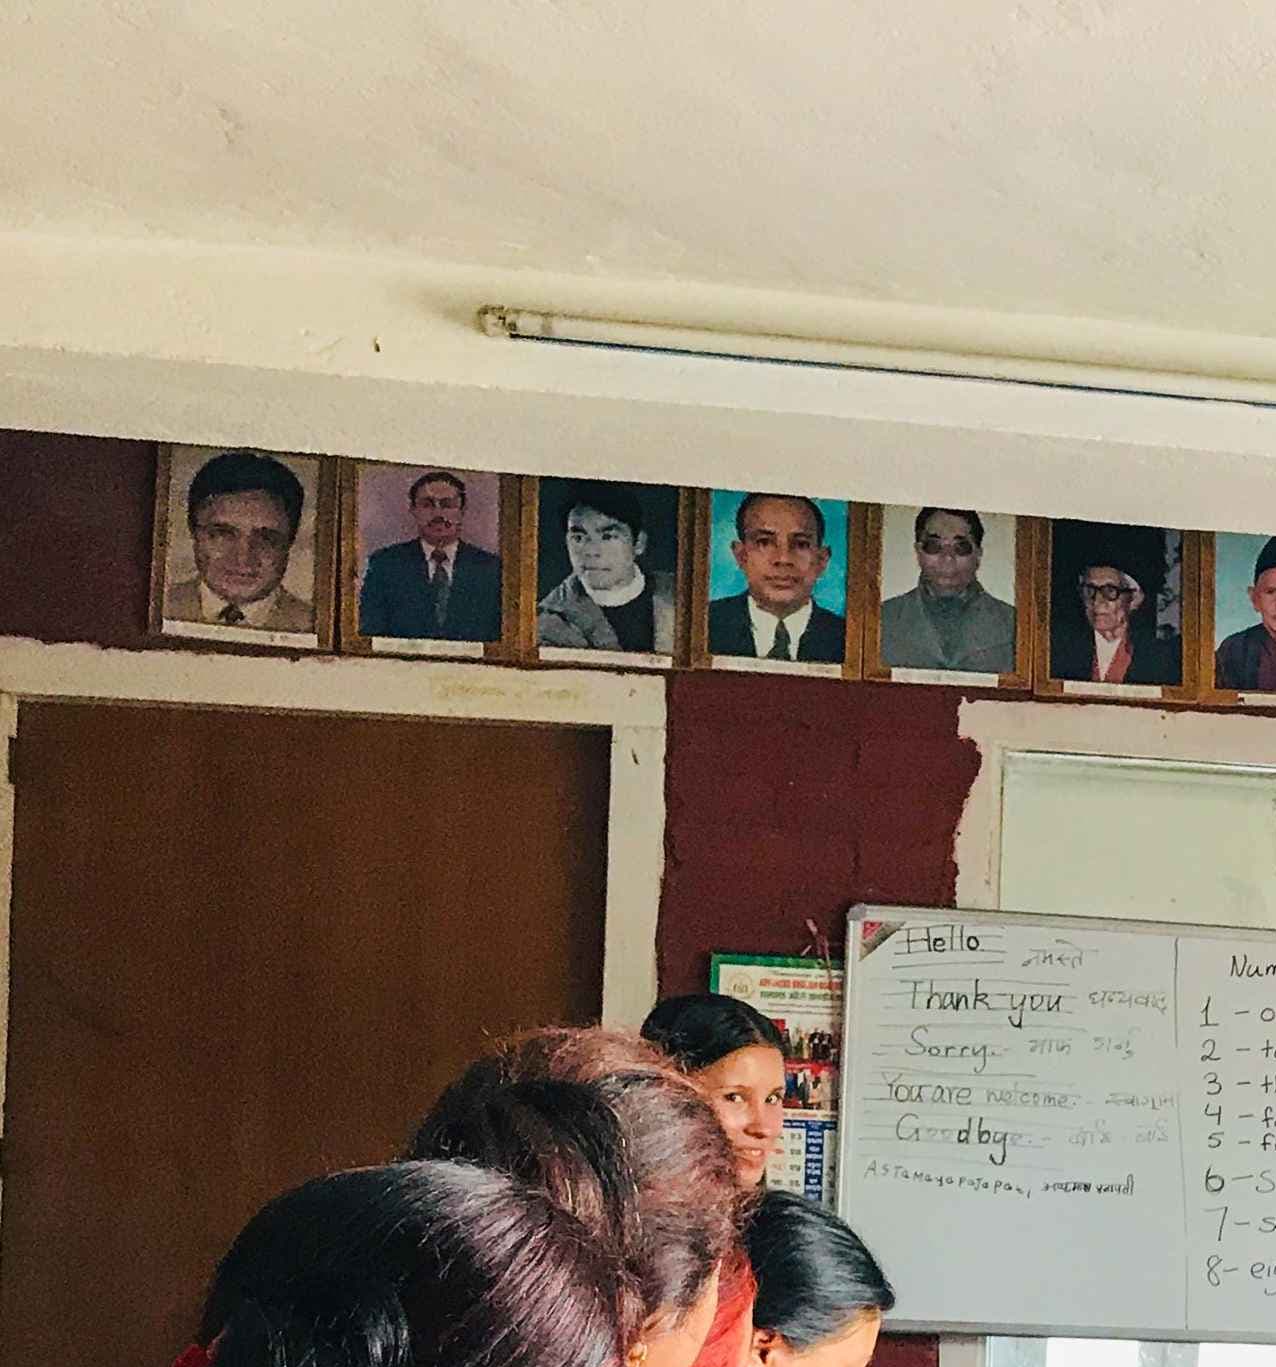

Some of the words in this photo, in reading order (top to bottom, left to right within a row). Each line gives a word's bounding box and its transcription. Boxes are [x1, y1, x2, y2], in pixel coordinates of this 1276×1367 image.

[905, 923, 982, 954] Hello
[911, 979, 988, 1012] Thank
[1007, 993, 1063, 1029] you
[1200, 996, 1219, 1027] 1
[1200, 1039, 1221, 1061] 2
[932, 1085, 973, 1107] are
[1203, 1072, 1222, 1096] 3
[1204, 1102, 1223, 1126] 4
[1207, 1131, 1225, 1149] 5
[1204, 1167, 1225, 1193] 6
[1203, 1205, 1228, 1242] 7
[1205, 1253, 1223, 1287] 8
